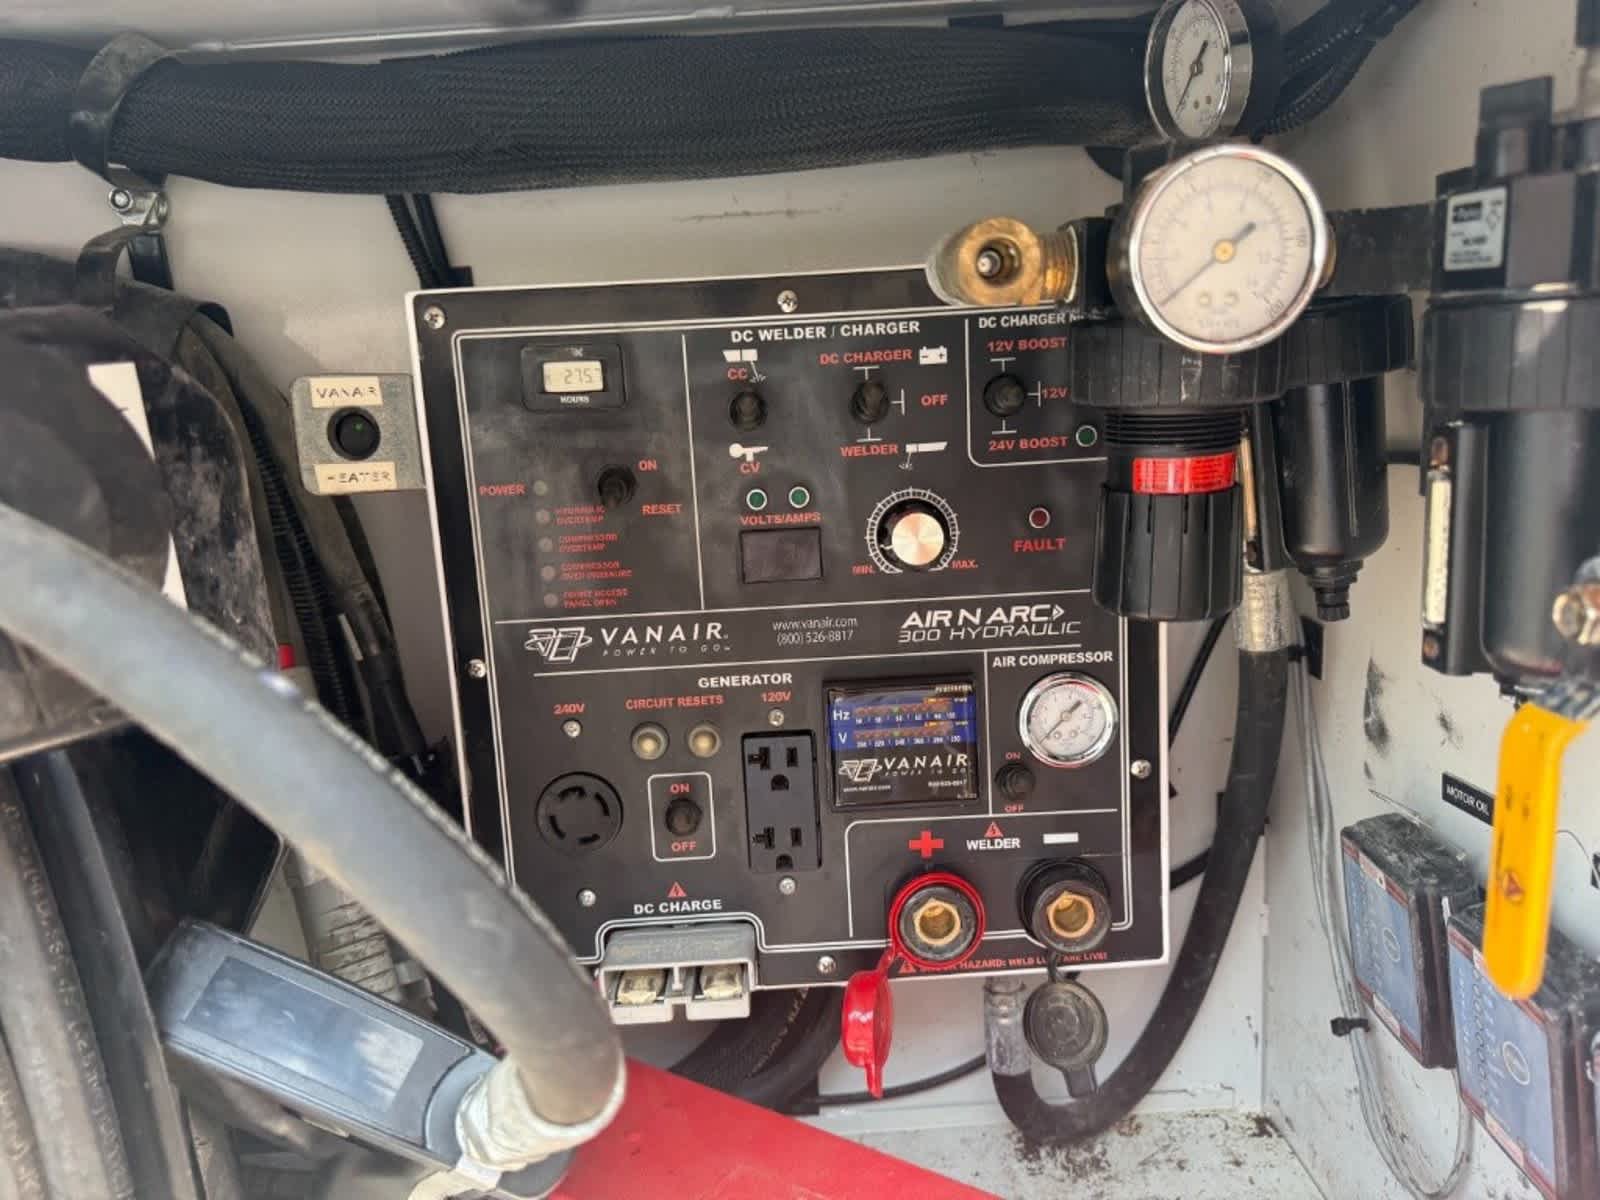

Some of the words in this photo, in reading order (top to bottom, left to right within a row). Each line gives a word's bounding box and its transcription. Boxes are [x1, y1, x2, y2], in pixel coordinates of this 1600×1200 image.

[979, 317, 997, 329] DC
[1000, 312, 1065, 327] CHARGER
[731, 331, 753, 343] DC
[758, 326, 827, 342] WELDER
[841, 321, 921, 337] CHARGER
[987, 340, 1014, 352] 12V
[1018, 337, 1068, 350] BOOST
[819, 353, 840, 365] DC
[842, 349, 913, 363] CHARGER
[727, 369, 749, 380] CC
[560, 395, 590, 404] HOURS
[1041, 387, 1068, 399] 12V
[921, 394, 949, 406] OFF
[989, 439, 1016, 451] 24V
[1020, 436, 1068, 449] BOOST
[841, 444, 899, 457] WELDER
[639, 459, 658, 471] ON
[740, 463, 761, 474] CV
[479, 484, 526, 496] POWER
[642, 503, 683, 516] RESET
[740, 511, 822, 526] VOLTS/AMPS
[1013, 539, 1066, 552] FAULT
[901, 610, 952, 629] AIR
[957, 608, 982, 626] N
[985, 604, 1052, 625] ARC
[772, 616, 858, 631] www.vanair.com
[601, 622, 723, 646] VANAIR
[776, 631, 803, 646] (800)
[806, 630, 854, 644] 526-8817
[898, 629, 941, 643] 300
[949, 621, 1082, 640] HYDRAULIC
[992, 656, 1016, 668] AIR
[1019, 651, 1113, 666] COMPRESSOR
[698, 673, 793, 688] GENERATOR
[625, 697, 674, 710] CIRCUIT
[677, 695, 724, 706] RESETS
[761, 692, 792, 702] 120V
[553, 704, 585, 714] 240V
[833, 709, 850, 721] Hz
[838, 732, 848, 744] V
[883, 754, 969, 770] VANAIR
[1005, 752, 1021, 760] ON
[670, 783, 690, 794] ON
[1446, 784, 1475, 807] MOTOR
[1475, 800, 1490, 816] OIL
[1004, 803, 1024, 813] OFF
[671, 842, 697, 852] OFF
[966, 838, 1021, 850] WELDER
[634, 902, 656, 915] DC
[659, 900, 722, 913] CHARGE
